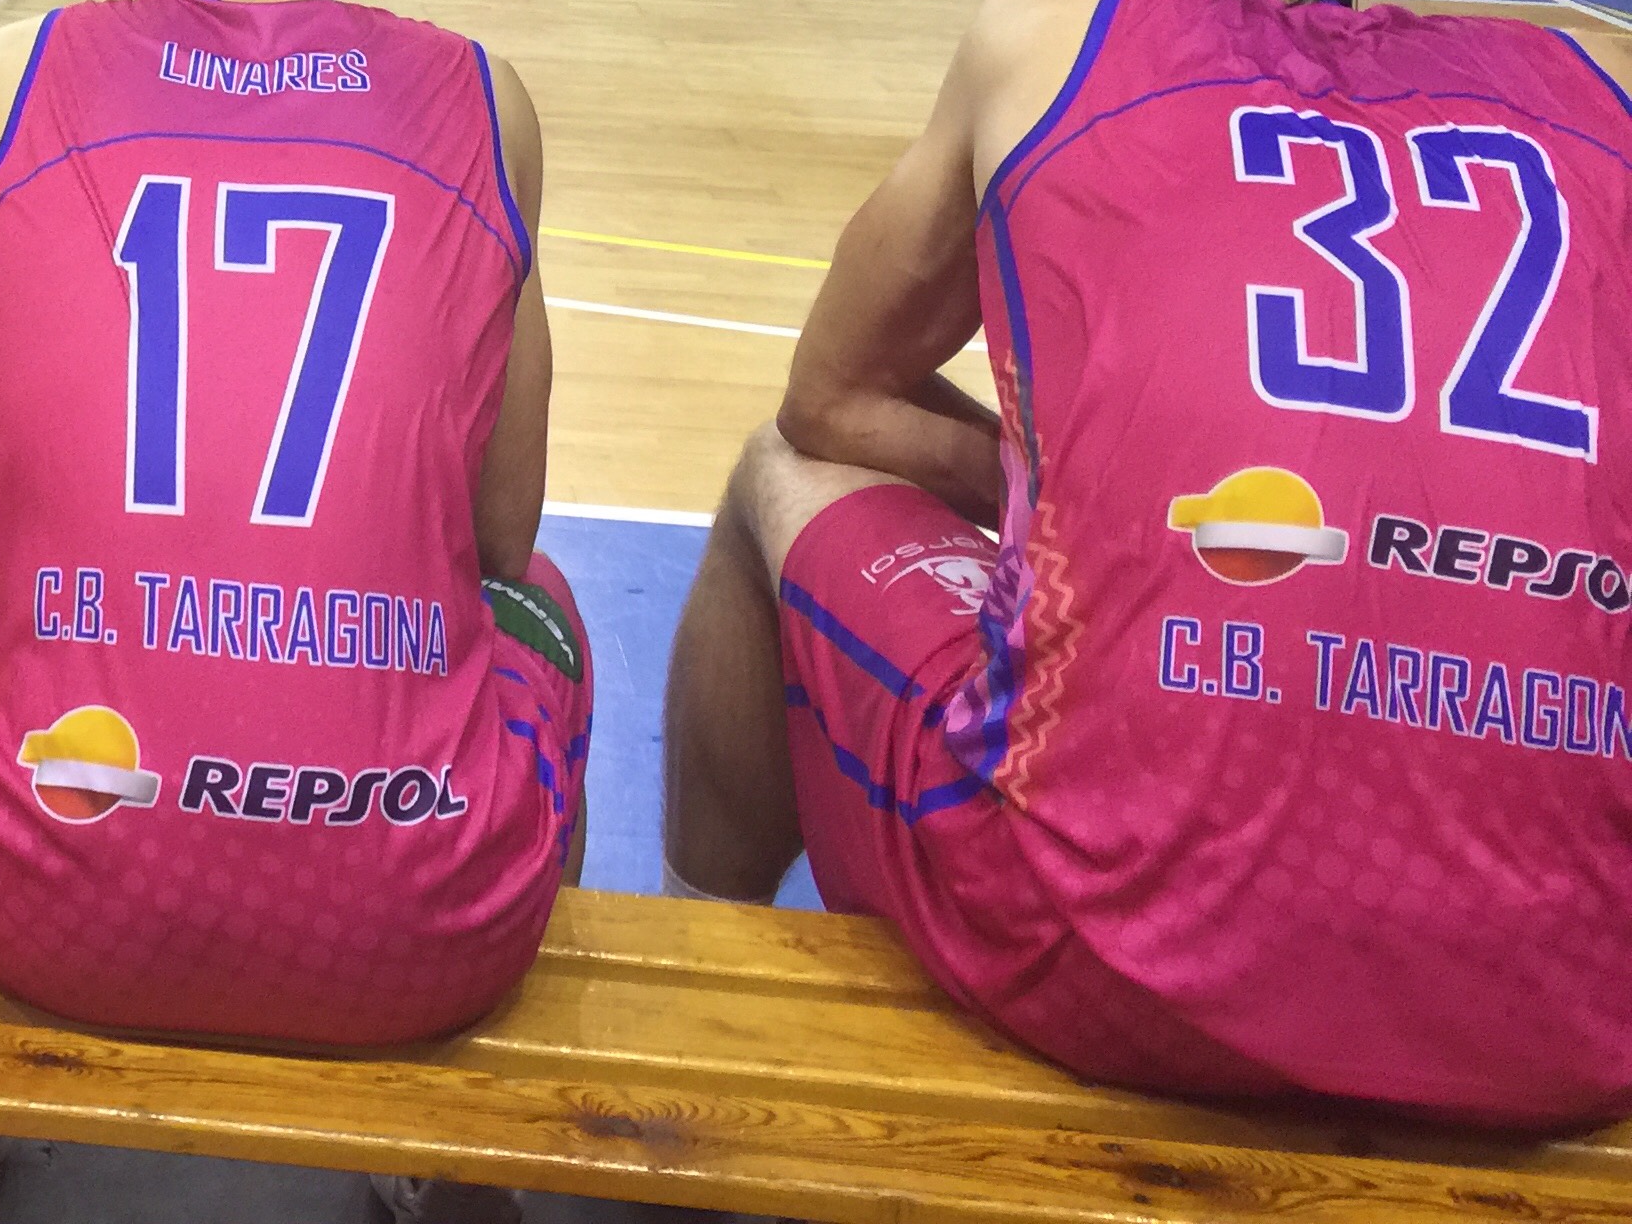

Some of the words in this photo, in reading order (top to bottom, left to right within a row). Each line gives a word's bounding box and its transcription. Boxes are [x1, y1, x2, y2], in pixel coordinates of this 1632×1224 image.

[159, 41, 371, 96] LINARES
[1230, 104, 1598, 463] 32
[113, 174, 395, 527] 17
[33, 567, 116, 646] C.B.
[135, 572, 448, 677] TARRAGONA
[1158, 616, 1283, 706] C.B.
[180, 757, 467, 826] REPSOL
